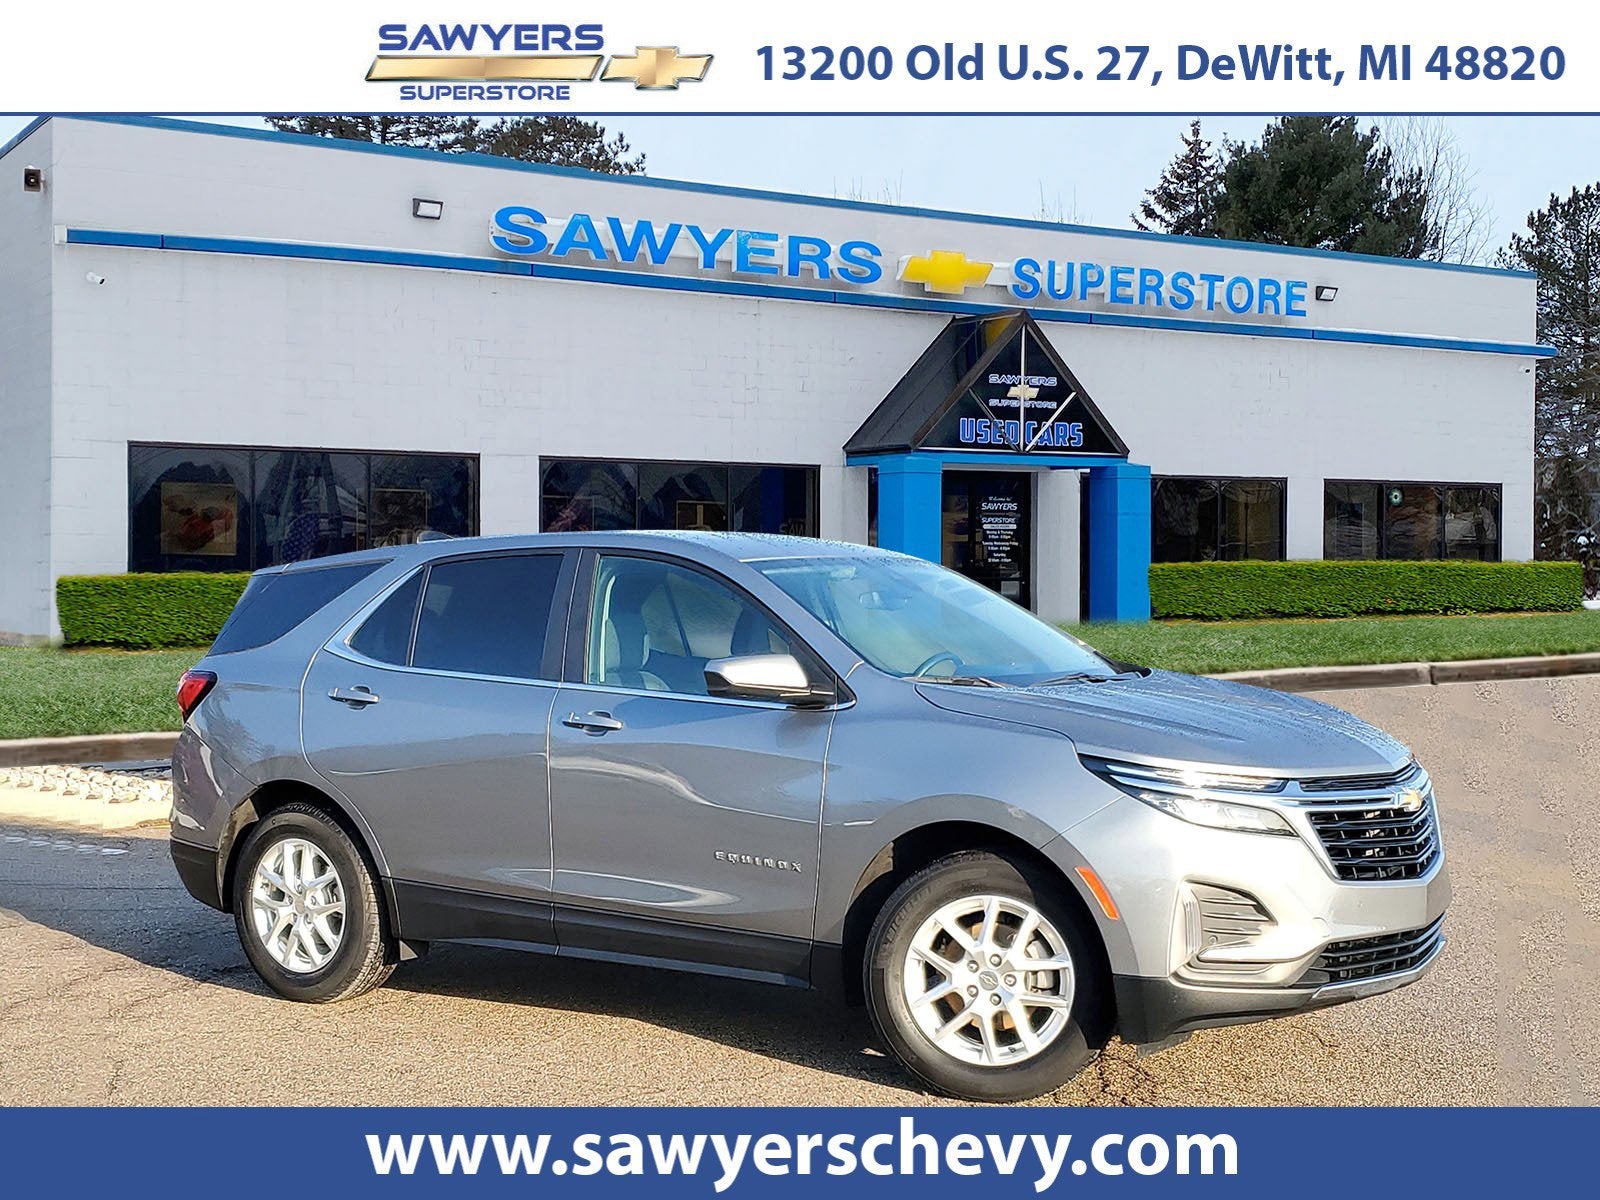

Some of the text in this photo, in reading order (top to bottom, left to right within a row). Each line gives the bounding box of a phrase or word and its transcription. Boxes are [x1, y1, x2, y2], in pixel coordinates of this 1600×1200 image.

[489, 205, 883, 284] SAWYERS
[1009, 257, 1309, 317] SUPERSTORE
[988, 373, 1058, 387] SAWYERS
[960, 417, 1084, 447] USED CARS
[981, 502, 1018, 511] SAWYERS
[714, 850, 802, 873] EQUINOX
